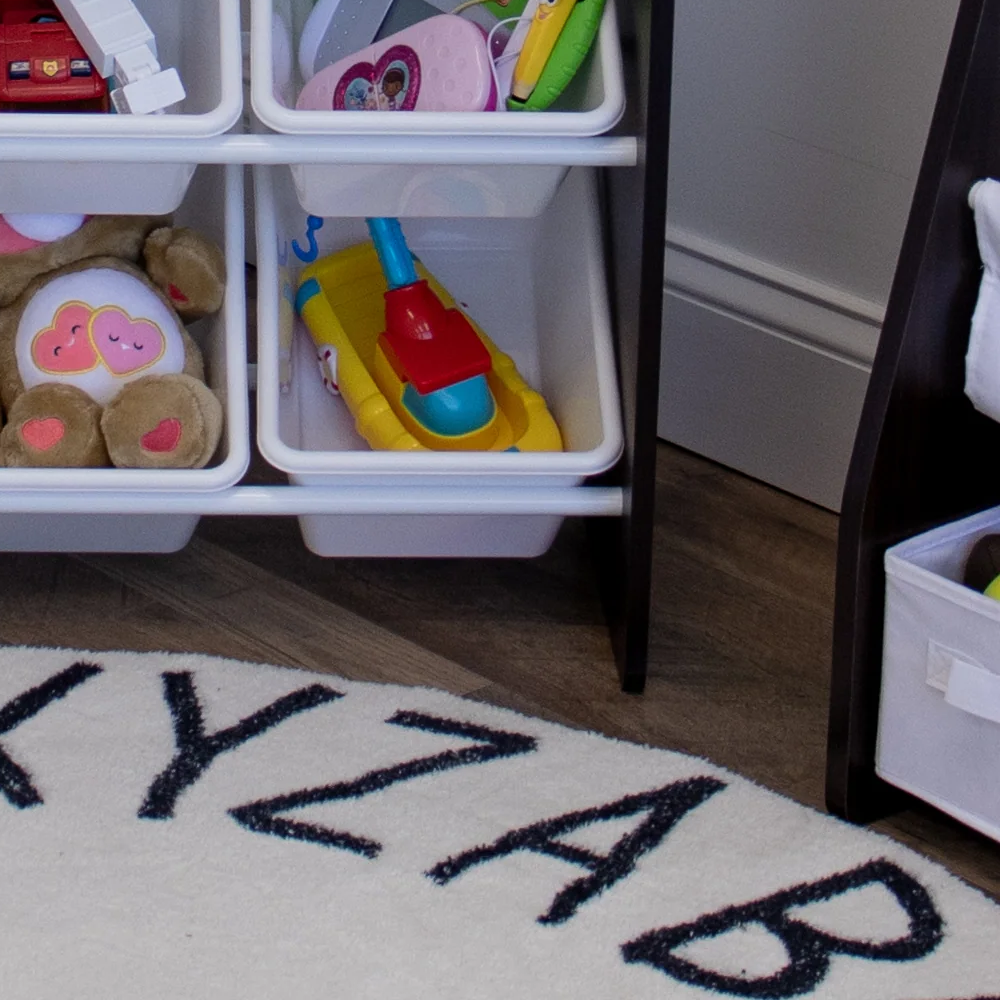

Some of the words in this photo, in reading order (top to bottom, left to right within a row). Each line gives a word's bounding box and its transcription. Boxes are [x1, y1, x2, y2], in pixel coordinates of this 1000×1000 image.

[137, 671, 346, 820] Y
[229, 709, 538, 859] Z
[424, 775, 728, 926] A
[620, 857, 945, 1000] B
